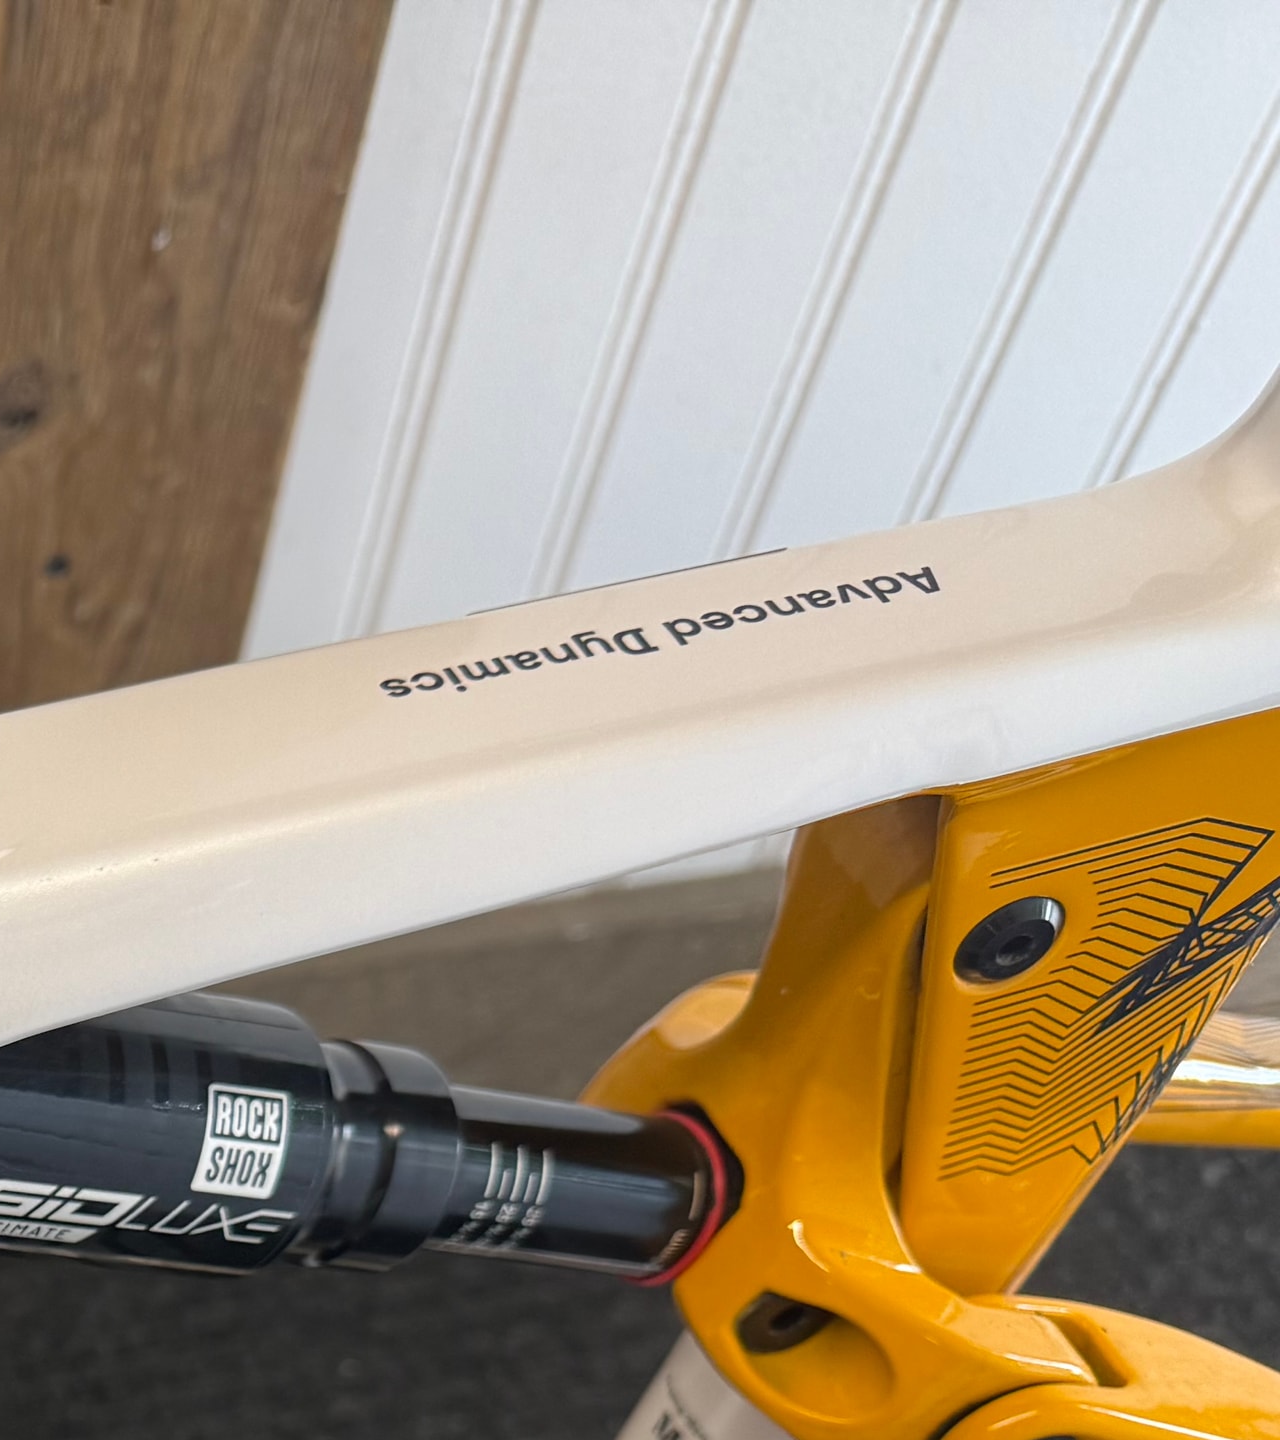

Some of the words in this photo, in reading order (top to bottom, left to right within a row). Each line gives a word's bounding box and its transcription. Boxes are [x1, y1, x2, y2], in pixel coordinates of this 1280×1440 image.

[661, 565, 942, 648] Advanced
[378, 625, 660, 699] Dynamics
[214, 1095, 282, 1143] ROCK
[204, 1145, 276, 1189] SHOX
